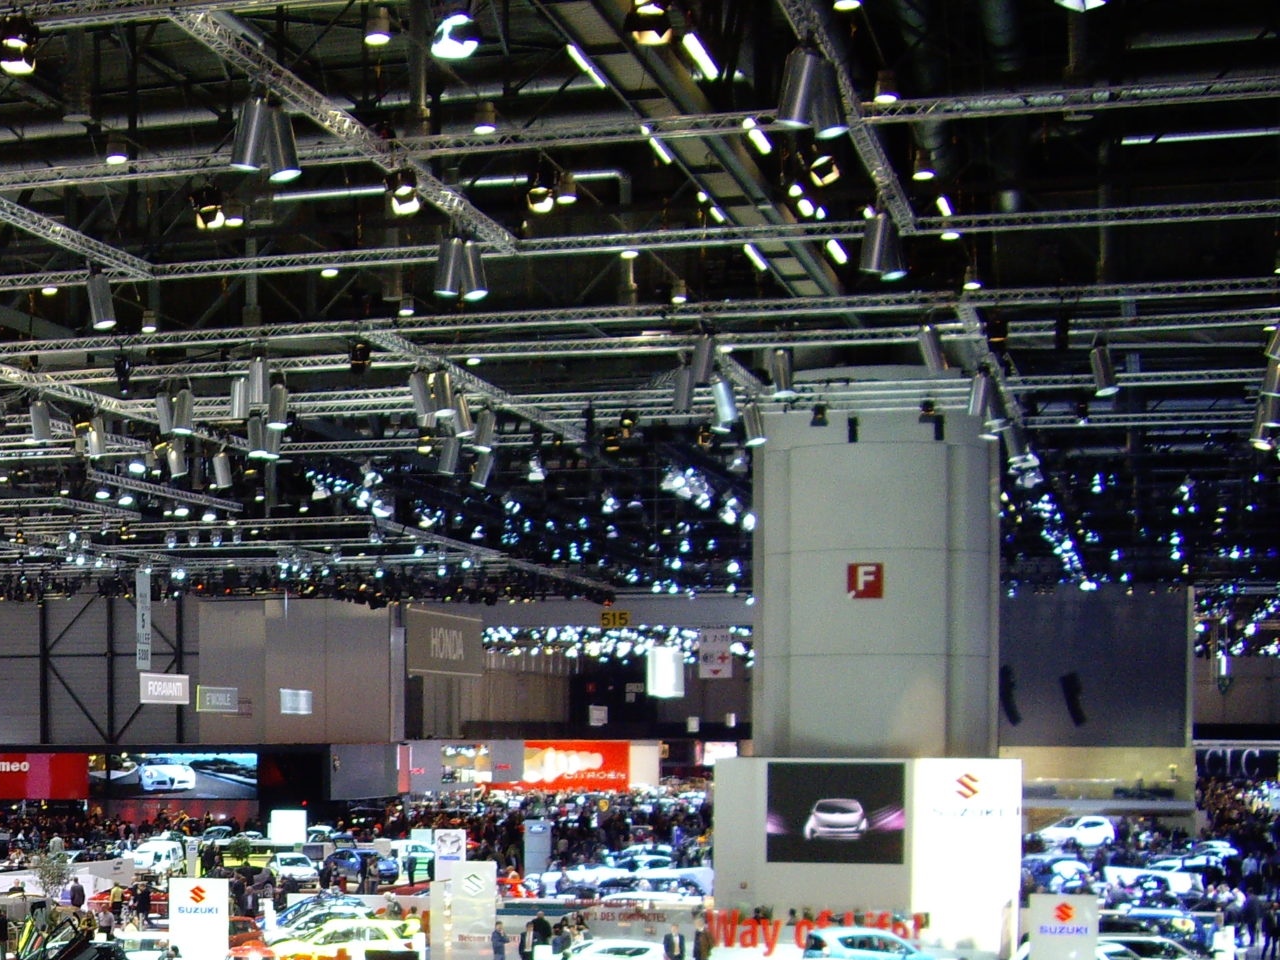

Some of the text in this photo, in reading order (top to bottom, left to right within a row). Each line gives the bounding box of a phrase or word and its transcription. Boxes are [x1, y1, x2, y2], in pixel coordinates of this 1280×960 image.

[856, 565, 876, 590] F
[600, 612, 629, 626] 515
[430, 628, 465, 660] HONDA
[148, 681, 183, 697] FIORAVANTI
[178, 906, 219, 914] SUZUKI
[706, 908, 783, 957] Way
[1039, 926, 1088, 935] SUZUKI
